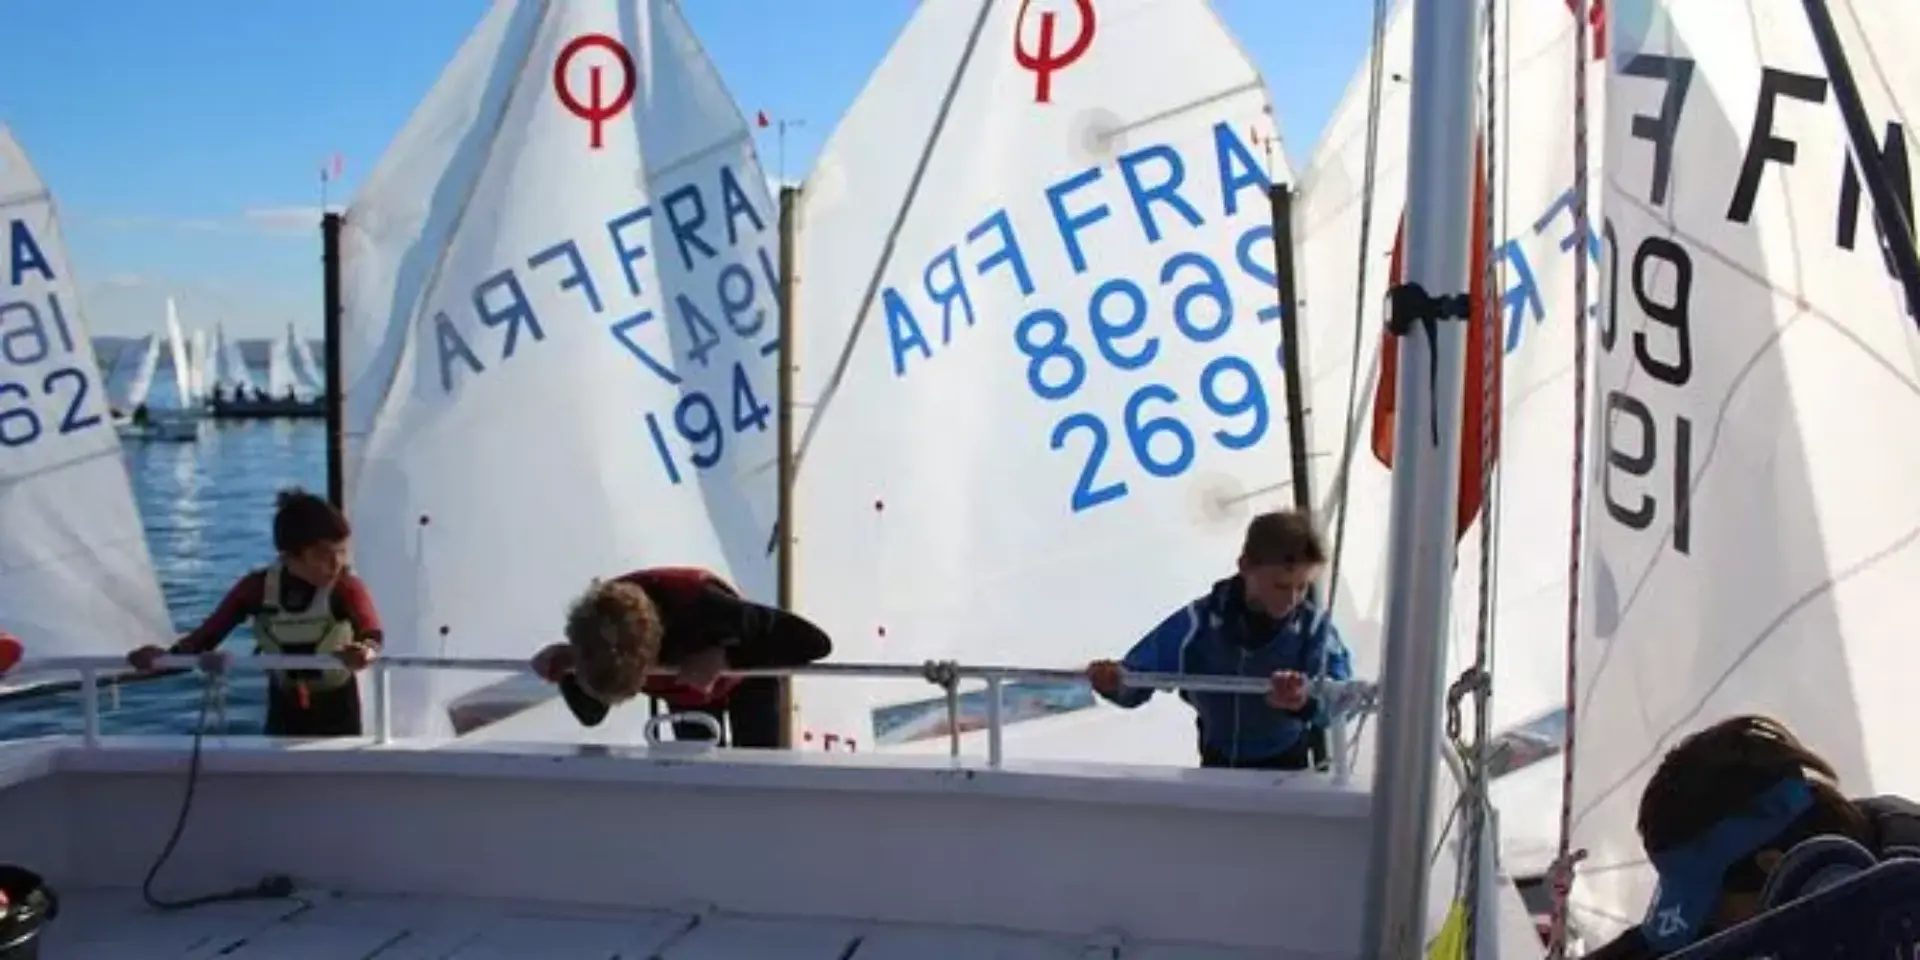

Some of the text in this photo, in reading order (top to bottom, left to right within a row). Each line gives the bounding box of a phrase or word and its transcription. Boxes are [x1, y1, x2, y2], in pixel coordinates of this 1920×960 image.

[606, 164, 766, 297] FRA
[1044, 120, 1272, 274] FRA
[645, 338, 781, 485] 194
[1049, 345, 1286, 514] 269
